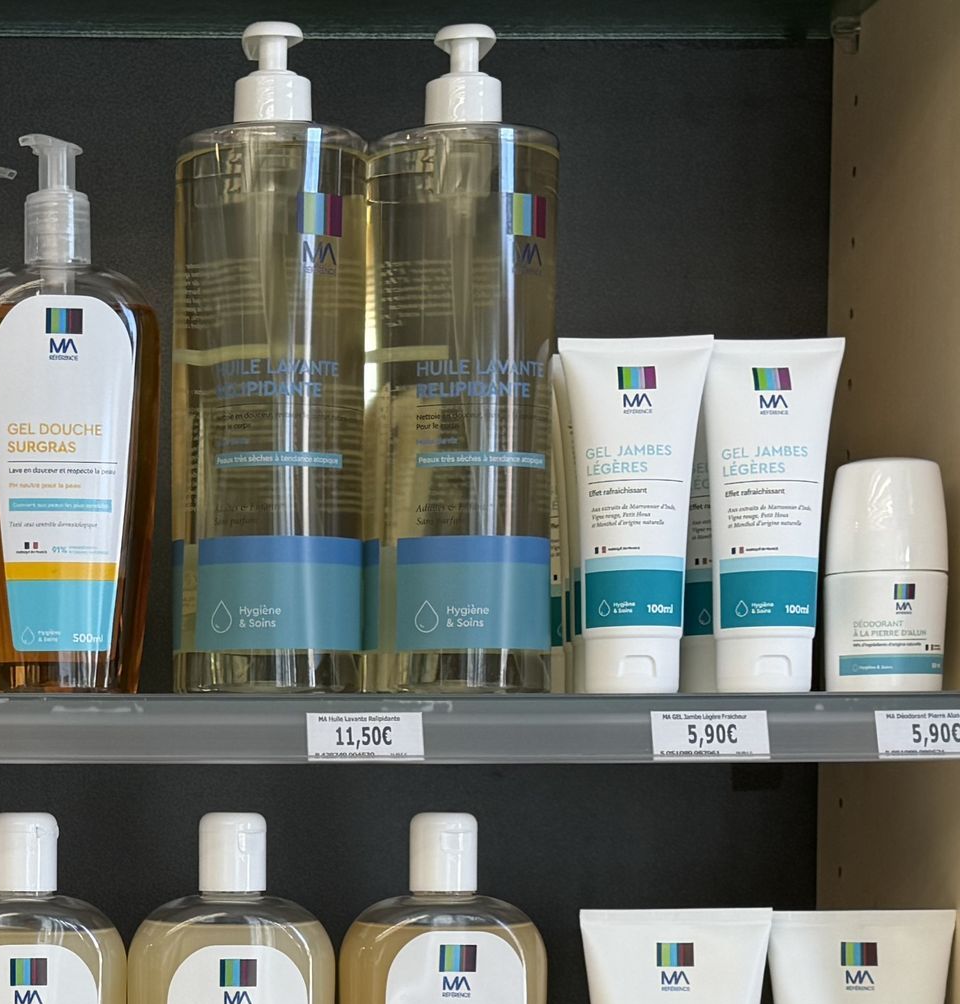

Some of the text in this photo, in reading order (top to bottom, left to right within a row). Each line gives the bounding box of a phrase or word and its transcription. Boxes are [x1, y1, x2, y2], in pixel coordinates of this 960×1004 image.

[417, 359, 545, 378] HUILE LAVANTE
[417, 382, 530, 399] RELIPIDANTE
[623, 394, 652, 408] MA
[8, 423, 103, 436] GEL DOUCHE
[8, 441, 77, 454] SURGRAS
[586, 444, 672, 459] GEL JAMBES
[722, 445, 809, 460] GEL JAMBES
[418, 456, 440, 464] Peaux
[441, 454, 455, 464] très
[456, 454, 481, 463] sèches
[587, 460, 648, 476] LÉGÈRES
[723, 460, 785, 478] LÉGÈRES
[725, 489, 740, 498] Effet
[446, 605, 490, 618] Hygiène
[646, 603, 674, 615] 100ml
[446, 618, 484, 628] & Soins
[853, 619, 904, 629] DÉODORANT
[73, 633, 104, 644] 500ml
[859, 629, 869, 637] LA
[871, 629, 899, 637] PIERRE
[335, 726, 392, 750] 11,50€
[687, 724, 738, 748] 5,90€
[912, 723, 960, 747] 5,90€
[661, 971, 690, 985] MA
